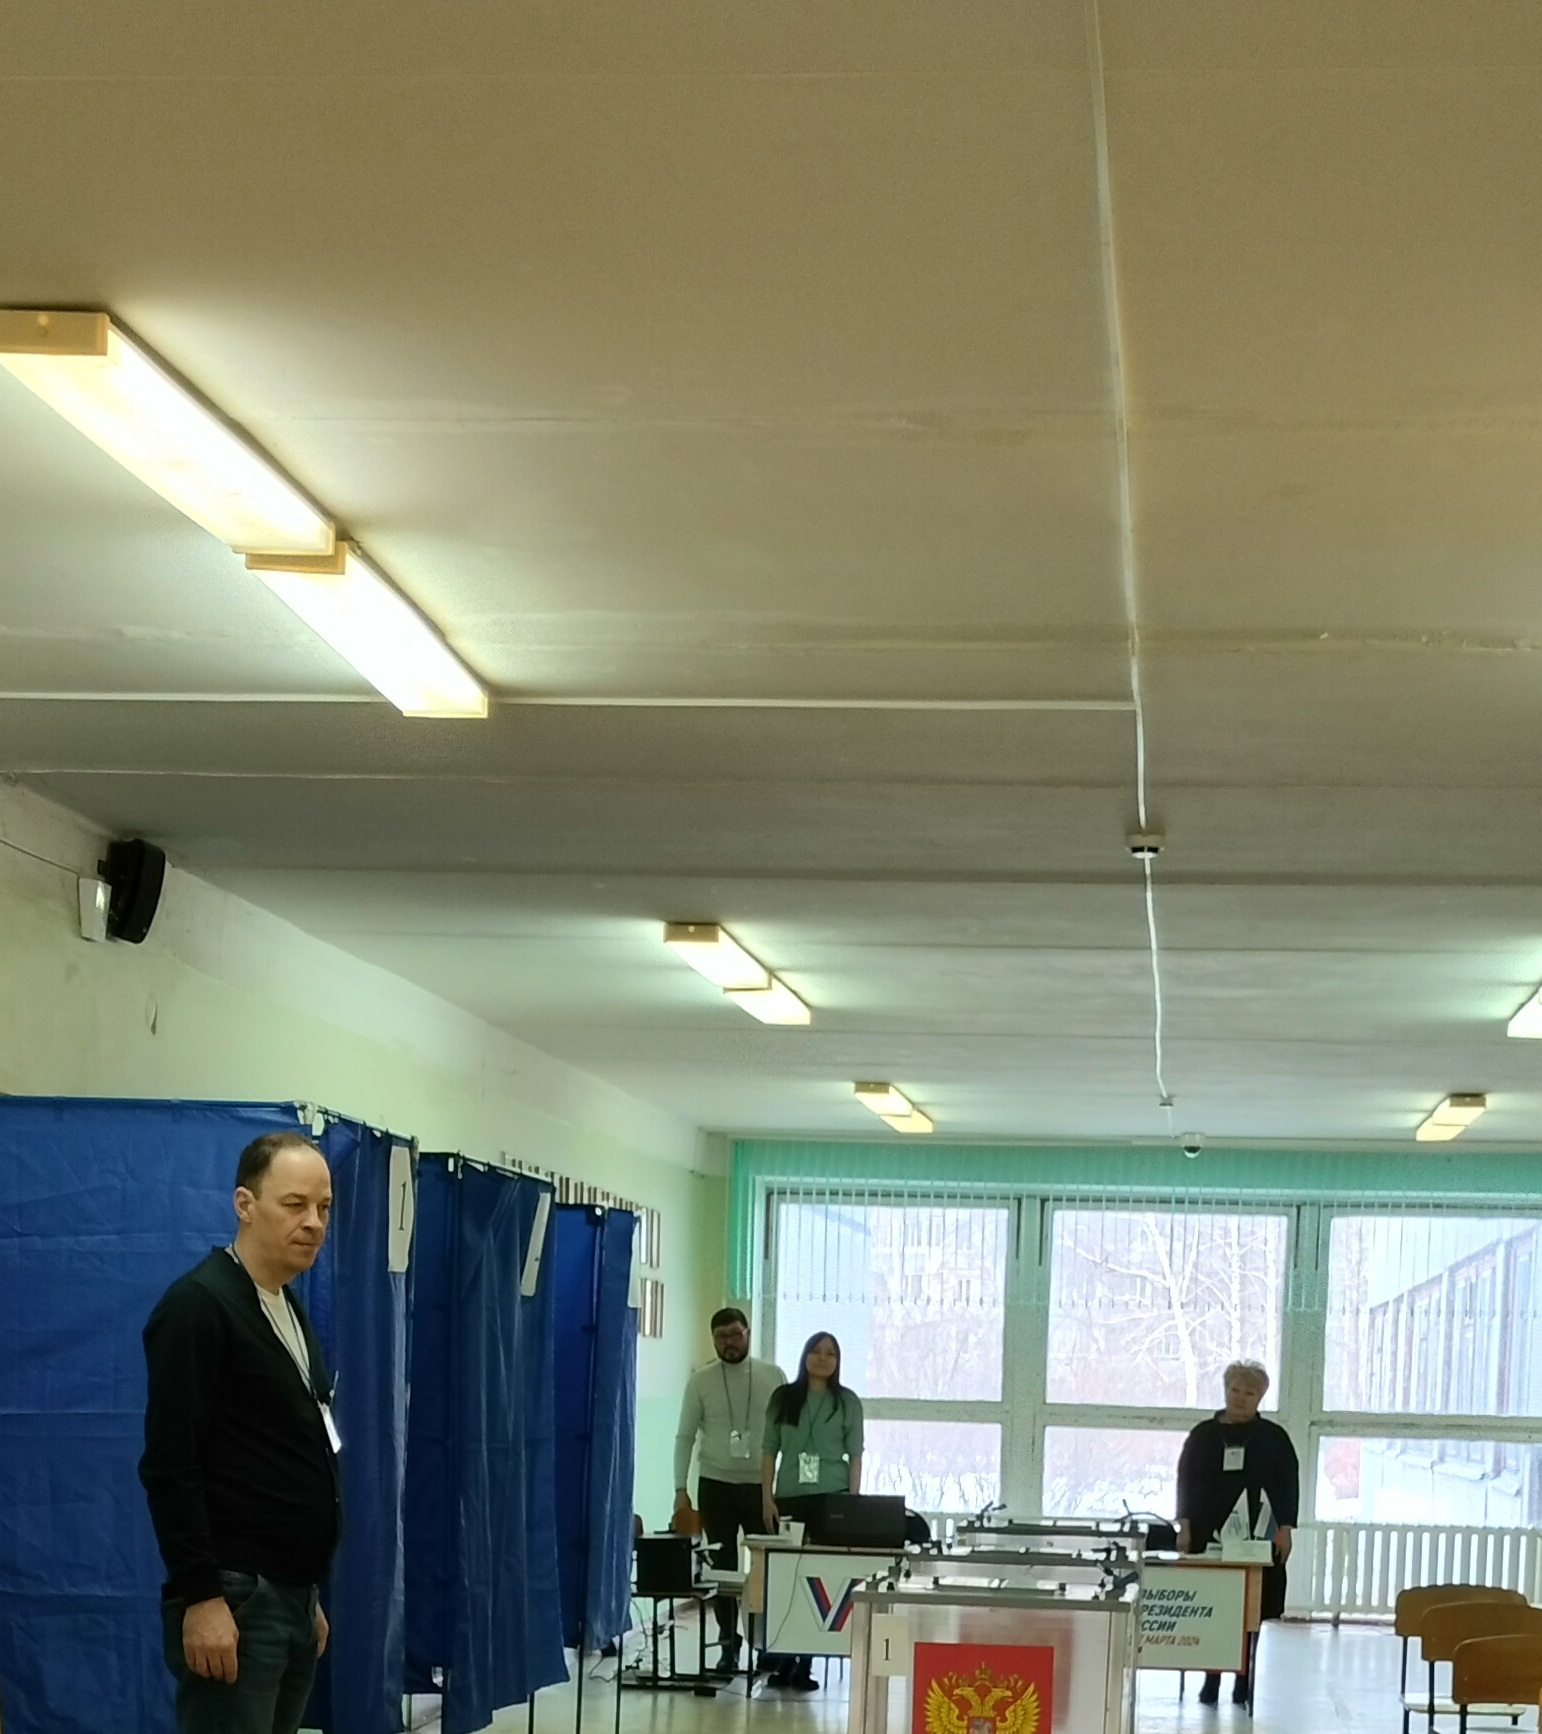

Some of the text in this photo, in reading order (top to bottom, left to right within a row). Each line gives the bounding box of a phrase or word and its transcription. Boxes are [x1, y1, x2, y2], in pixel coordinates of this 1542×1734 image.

[1141, 1604, 1214, 1618] РЕЗИДЕНТА
[1141, 1620, 1177, 1632] ССИИ
[883, 1637, 891, 1661] 1
